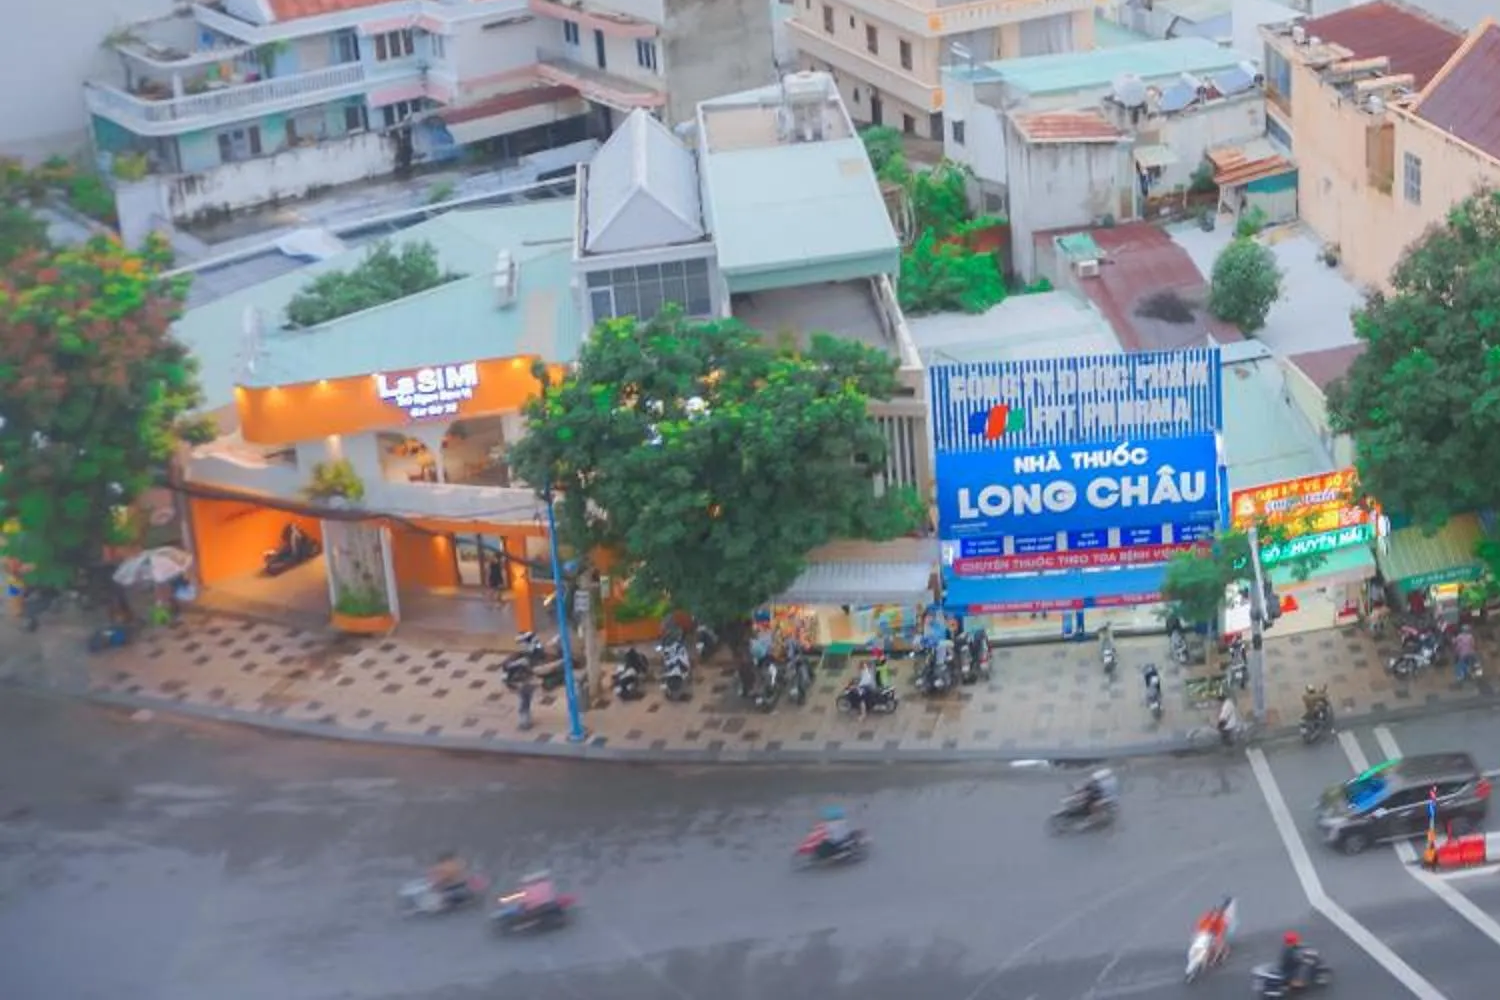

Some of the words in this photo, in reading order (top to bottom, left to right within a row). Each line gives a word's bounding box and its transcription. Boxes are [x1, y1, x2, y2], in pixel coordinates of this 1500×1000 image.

[1013, 449, 1062, 475] NHÀ
[1070, 441, 1149, 471] THUỐC
[957, 480, 1077, 520] LONG
[1086, 464, 1206, 509] CHÂU
